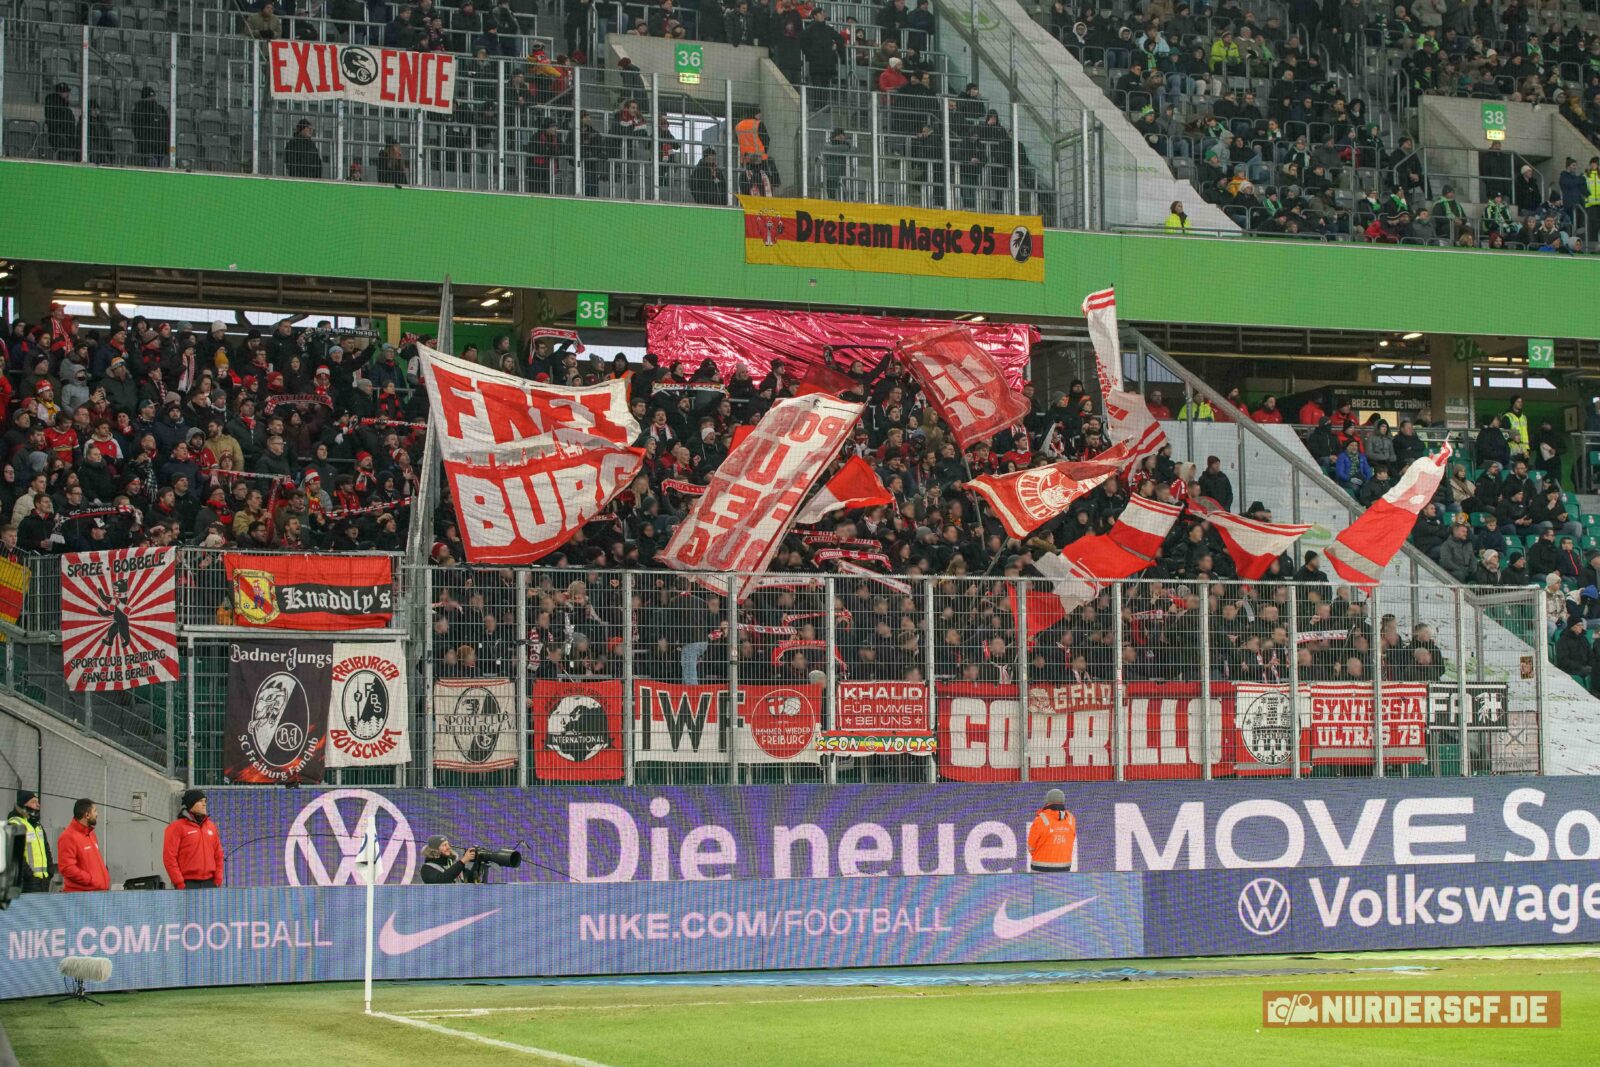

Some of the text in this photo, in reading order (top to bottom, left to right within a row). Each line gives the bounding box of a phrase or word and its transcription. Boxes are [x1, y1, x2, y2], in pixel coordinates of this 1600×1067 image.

[271, 41, 345, 93] EXIL
[678, 51, 700, 66] 36
[1485, 110, 1504, 124] 38
[796, 210, 995, 261] Dreisam Magic 95
[580, 301, 606, 319] 35
[1531, 346, 1553, 361] 37
[1352, 398, 1381, 409] BREZEL
[68, 562, 103, 578] SPREE
[113, 552, 166, 573] BOBBELE
[282, 586, 391, 614] Knaddly's
[71, 649, 166, 669] SPORTCLUB FREIBURG
[231, 644, 332, 671] Badner Jungs
[82, 665, 156, 682] FANCLUB BERLIN
[331, 655, 400, 682] FREIBURGER
[844, 686, 923, 700] KHALID
[843, 702, 923, 714] FÜR IMMER
[640, 686, 746, 752] IWF
[855, 716, 912, 726] BEI UNS
[552, 735, 605, 744] INTERNATIONAL
[761, 734, 805, 745] FREIBURG
[785, 726, 811, 735] WIEDER
[1398, 725, 1421, 745] 79
[330, 728, 402, 759] BOTSCHAFT
[881, 736, 935, 752] VOLTS
[238, 734, 319, 781] SC Freiburg Fanclub
[567, 797, 737, 882] Die
[773, 818, 1079, 877] neue
[1114, 798, 1476, 871] MOVE
[578, 906, 953, 941] NIKE.COM/FOOTBALL
[8, 918, 333, 961] NIKE.COM/FOOTBALL
